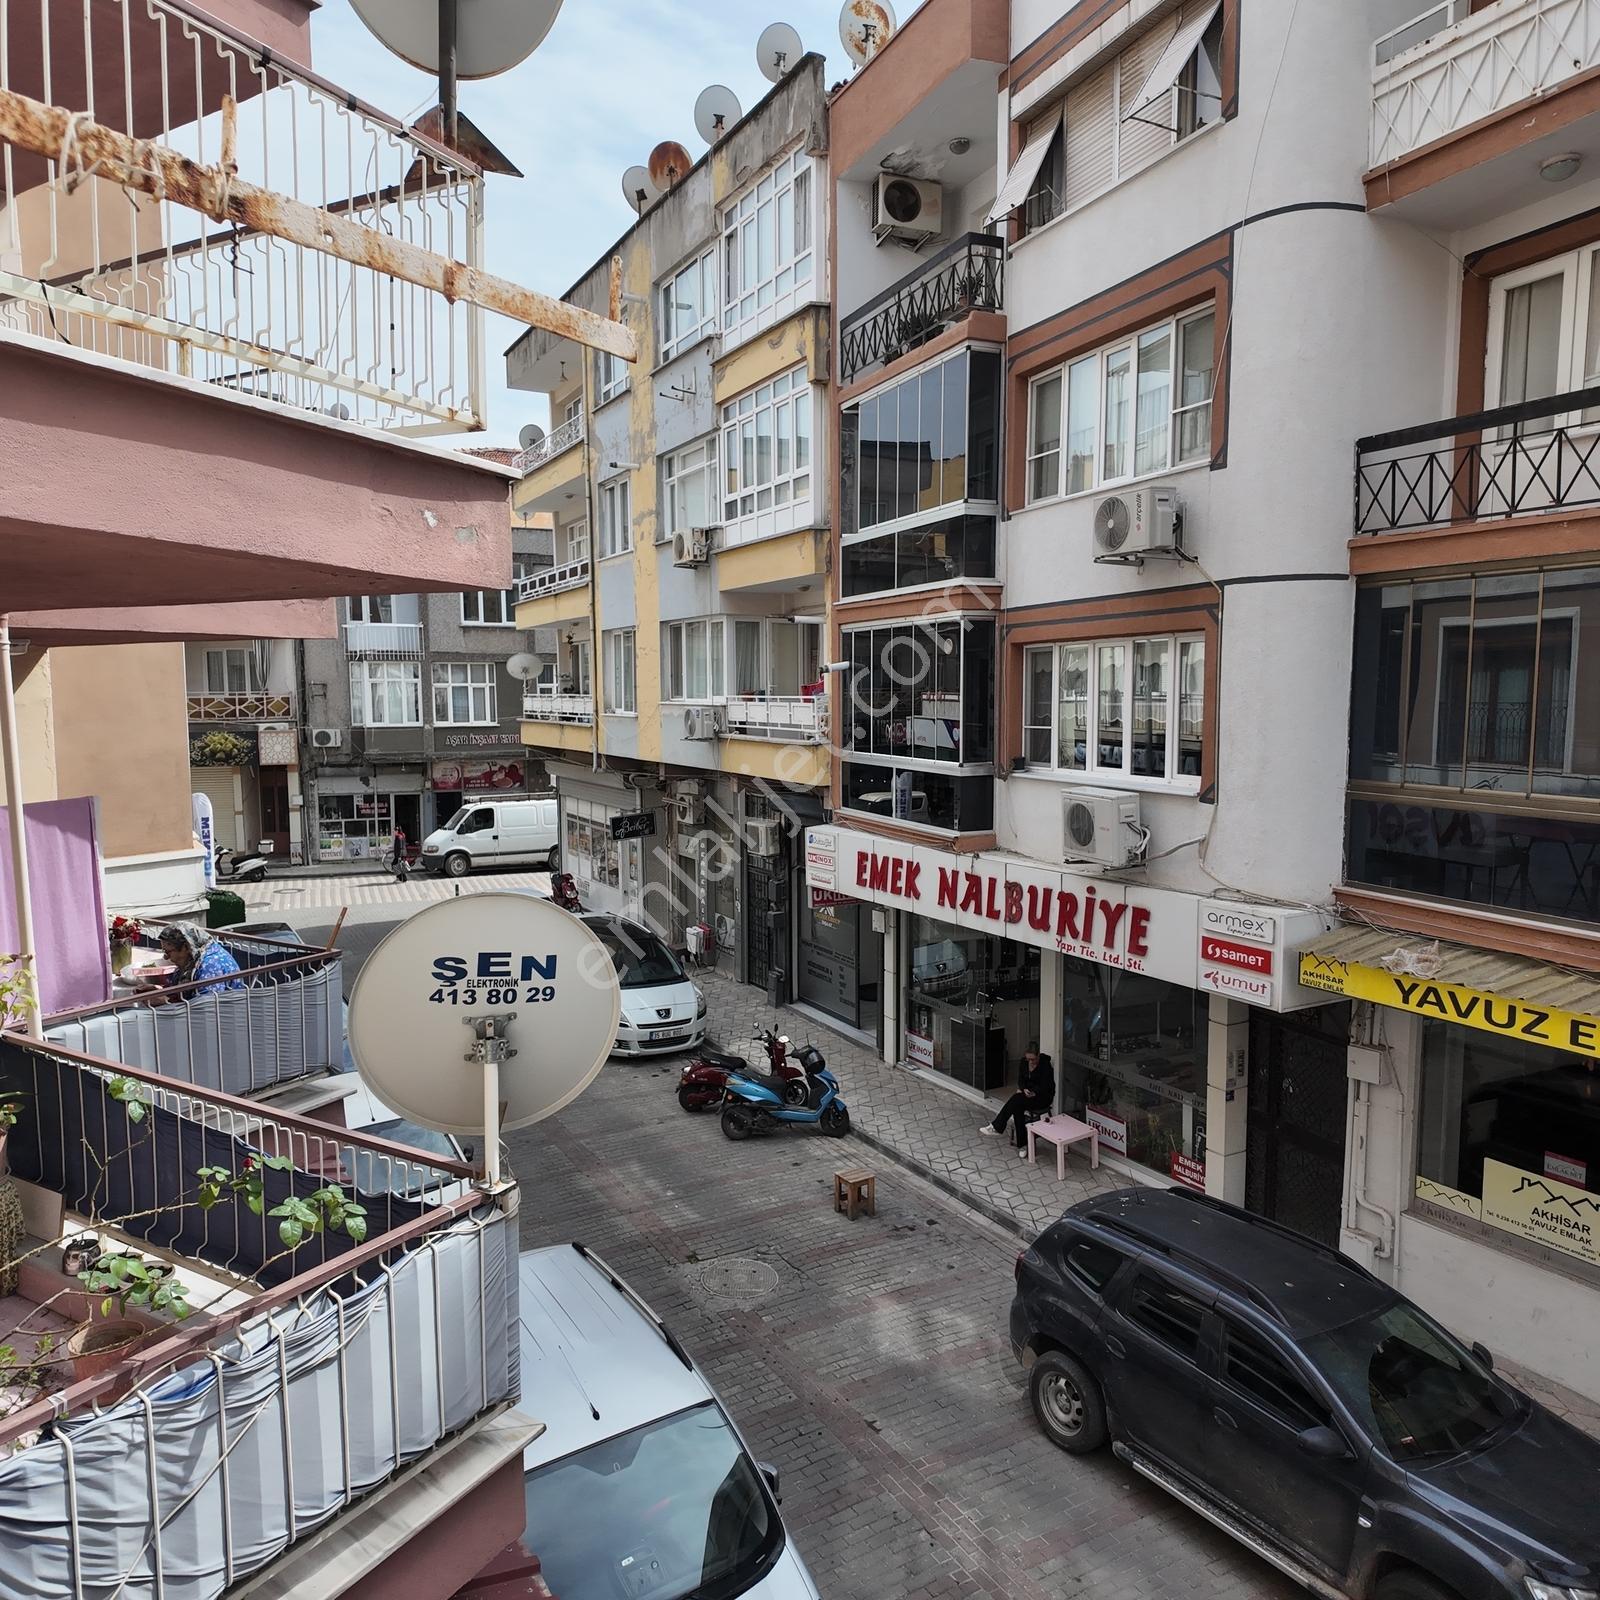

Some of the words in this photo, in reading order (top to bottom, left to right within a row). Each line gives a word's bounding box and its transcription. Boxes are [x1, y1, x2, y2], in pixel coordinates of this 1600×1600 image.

[808, 854, 834, 865] UKINOX
[856, 850, 922, 900] EMEK
[937, 865, 1152, 958] NALBURİYE
[1207, 912, 1266, 933] armex
[1055, 938, 1077, 954] Yapı
[1079, 944, 1098, 960] Tic.
[1102, 951, 1124, 966] Ltd.
[1126, 957, 1146, 972] Şti.
[431, 951, 558, 988] ŞEN
[1302, 969, 1344, 986] AKHİSAR
[466, 976, 520, 989] ELEKTRONİK
[1221, 974, 1268, 996] umut
[1301, 977, 1322, 988] YAVUZ
[1322, 982, 1345, 994] EMLAK
[428, 988, 478, 1006] 413
[486, 988, 518, 1005] 80
[525, 986, 556, 1003] 29
[1392, 977, 1550, 1041] YAVUZ
[907, 1040, 933, 1059] UKINOX
[1088, 1118, 1125, 1143] UKINOX
[1173, 1163, 1206, 1184] NALBURİY
[1178, 1155, 1203, 1174] EMEK
[1529, 1216, 1559, 1234] YAVUZ
[1559, 1229, 1593, 1247] EMLAK
[1531, 1206, 1592, 1237] AKHİSAR
